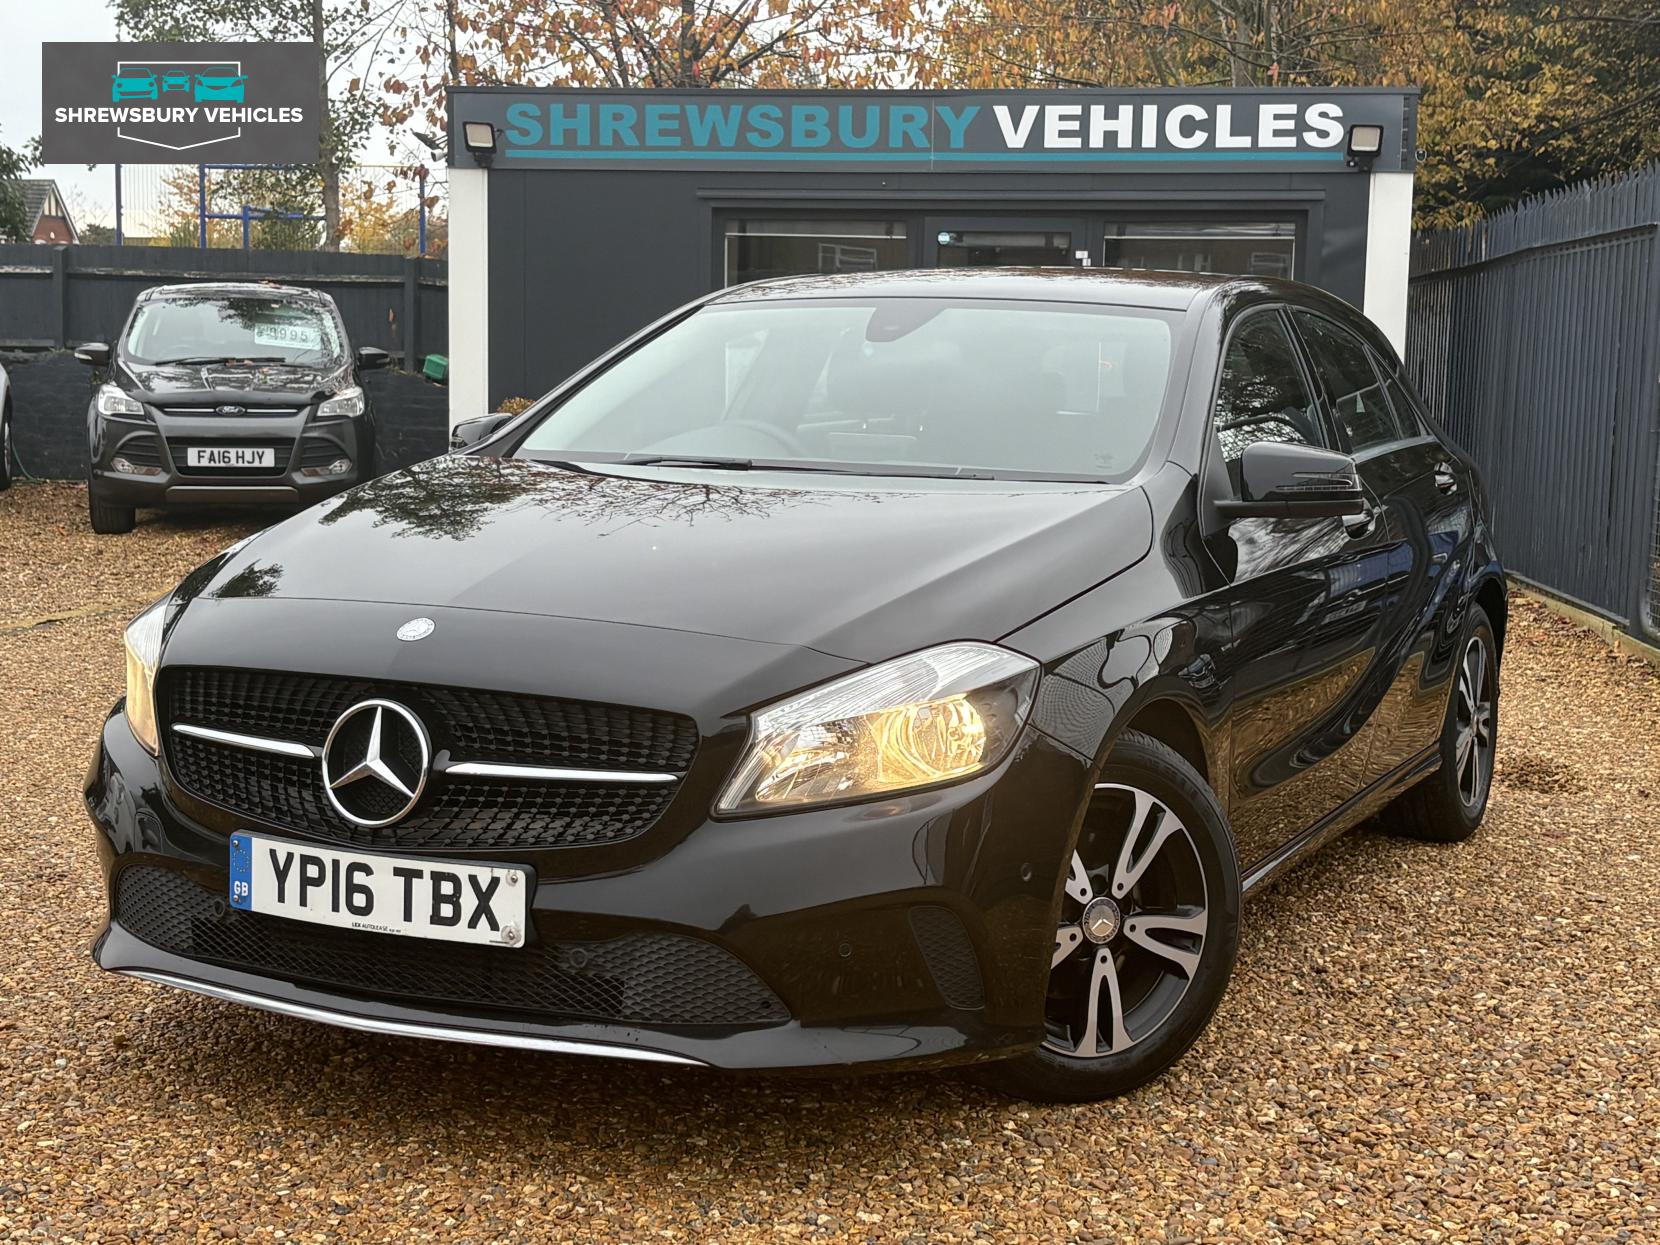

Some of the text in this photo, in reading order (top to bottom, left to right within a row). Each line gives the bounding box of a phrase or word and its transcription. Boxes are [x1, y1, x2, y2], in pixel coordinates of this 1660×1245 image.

[504, 102, 1346, 150] SHREWSBURY VEHICLES
[197, 450, 265, 465] FA16 HJY
[233, 880, 249, 897] GB
[268, 847, 501, 932] YP16 TBX
